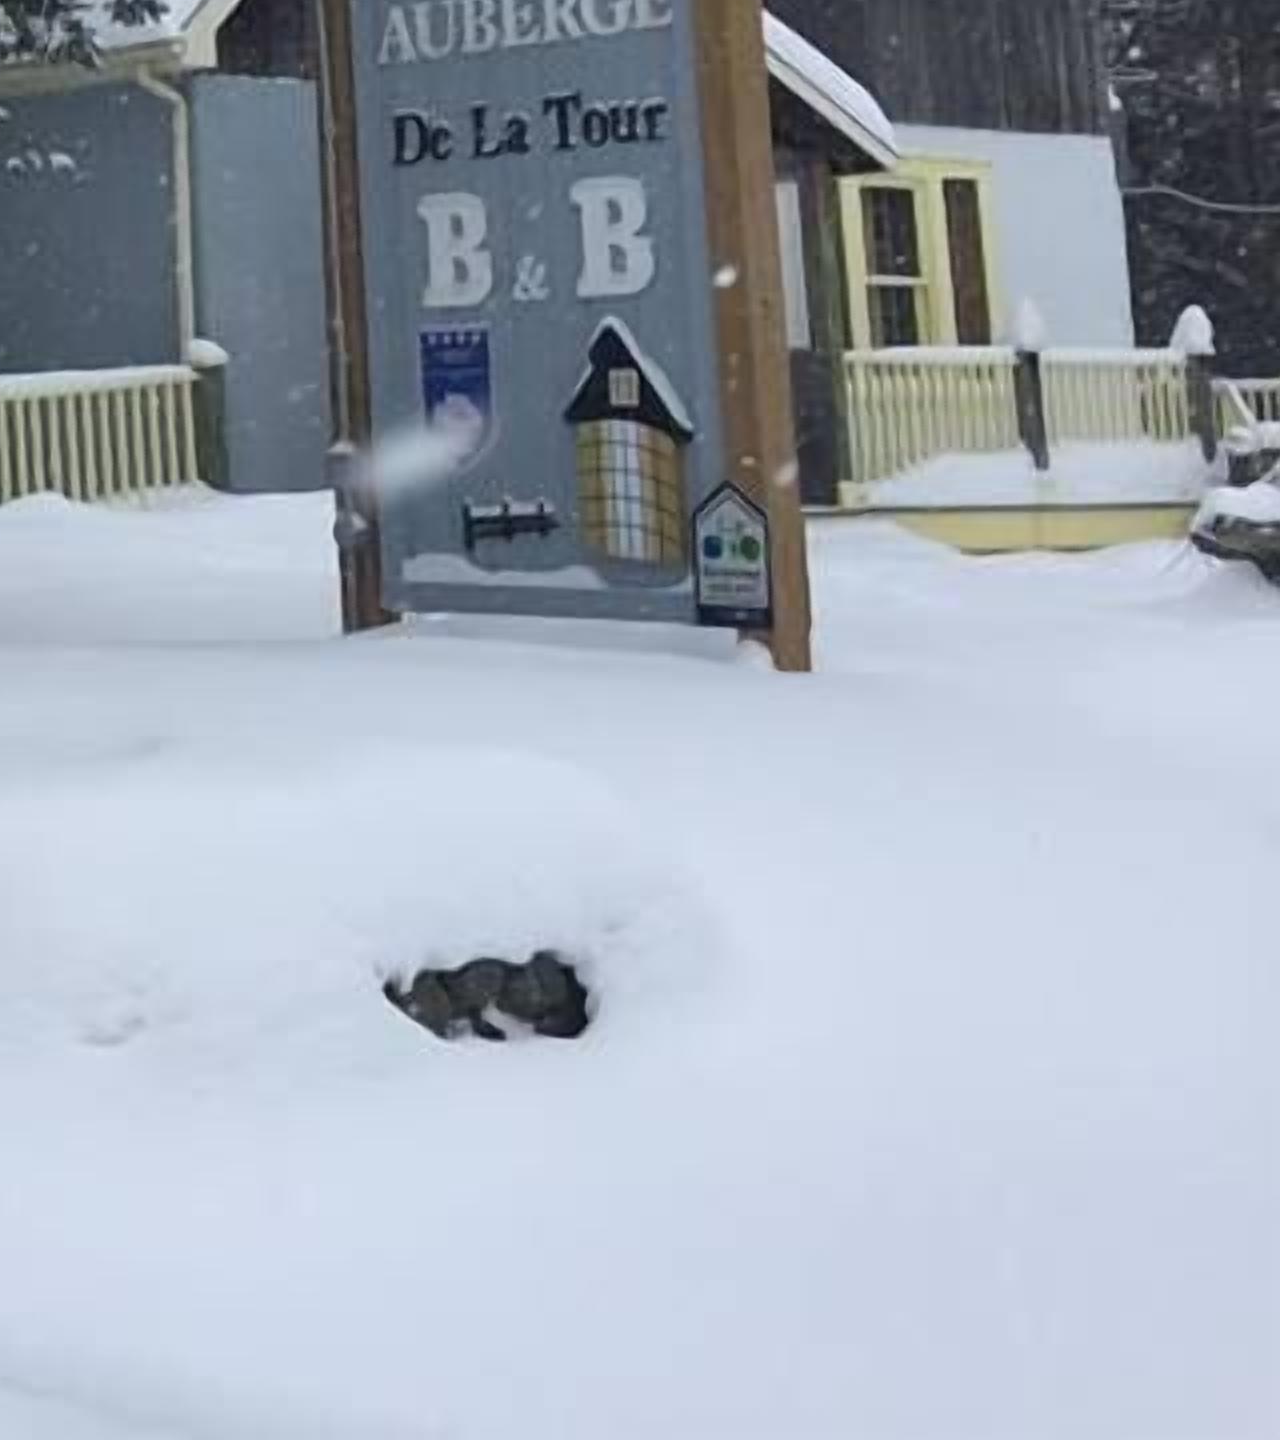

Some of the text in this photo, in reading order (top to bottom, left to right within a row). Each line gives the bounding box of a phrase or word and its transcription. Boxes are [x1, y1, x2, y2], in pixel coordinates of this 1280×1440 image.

[392, 90, 669, 167] De La Tour
[417, 176, 655, 306] B & B
